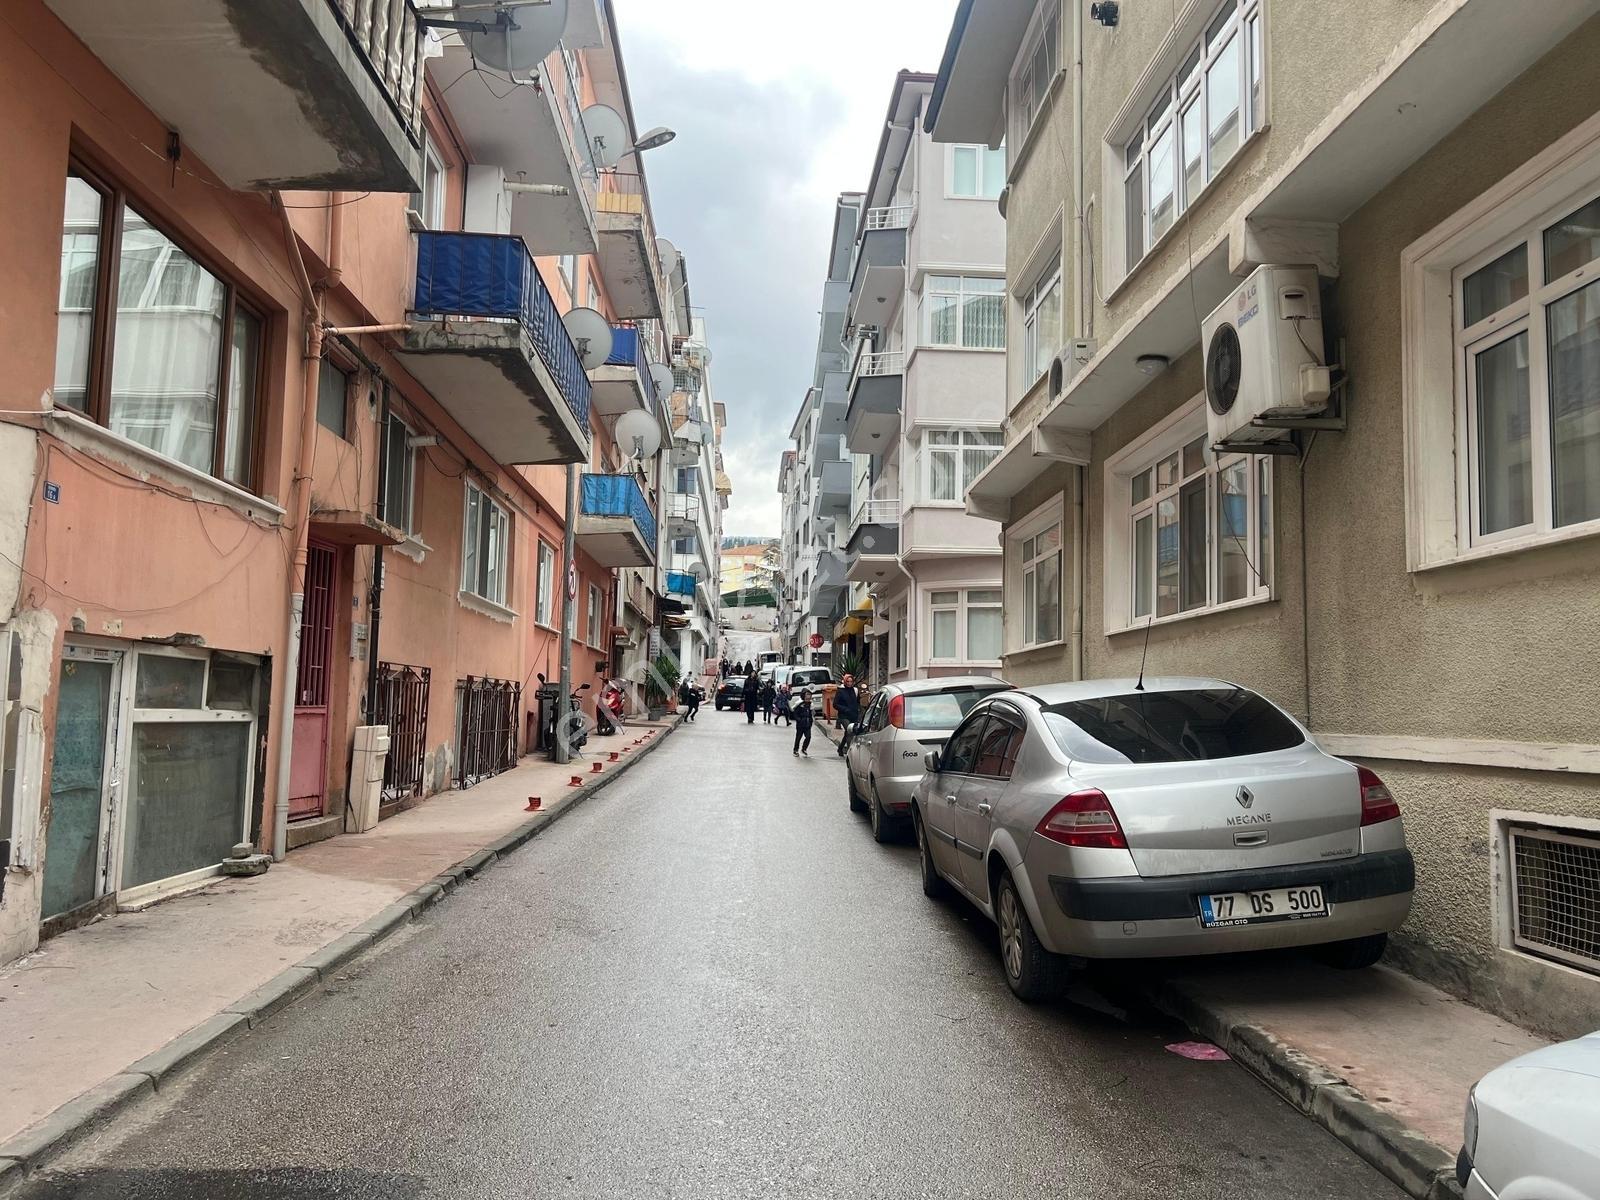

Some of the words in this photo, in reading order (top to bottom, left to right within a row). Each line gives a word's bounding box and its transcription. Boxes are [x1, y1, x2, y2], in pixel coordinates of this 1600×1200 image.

[1247, 285, 1257, 300] LG
[1213, 896, 1235, 918] 77
[1250, 892, 1274, 914] DS
[1287, 889, 1321, 911] 500
